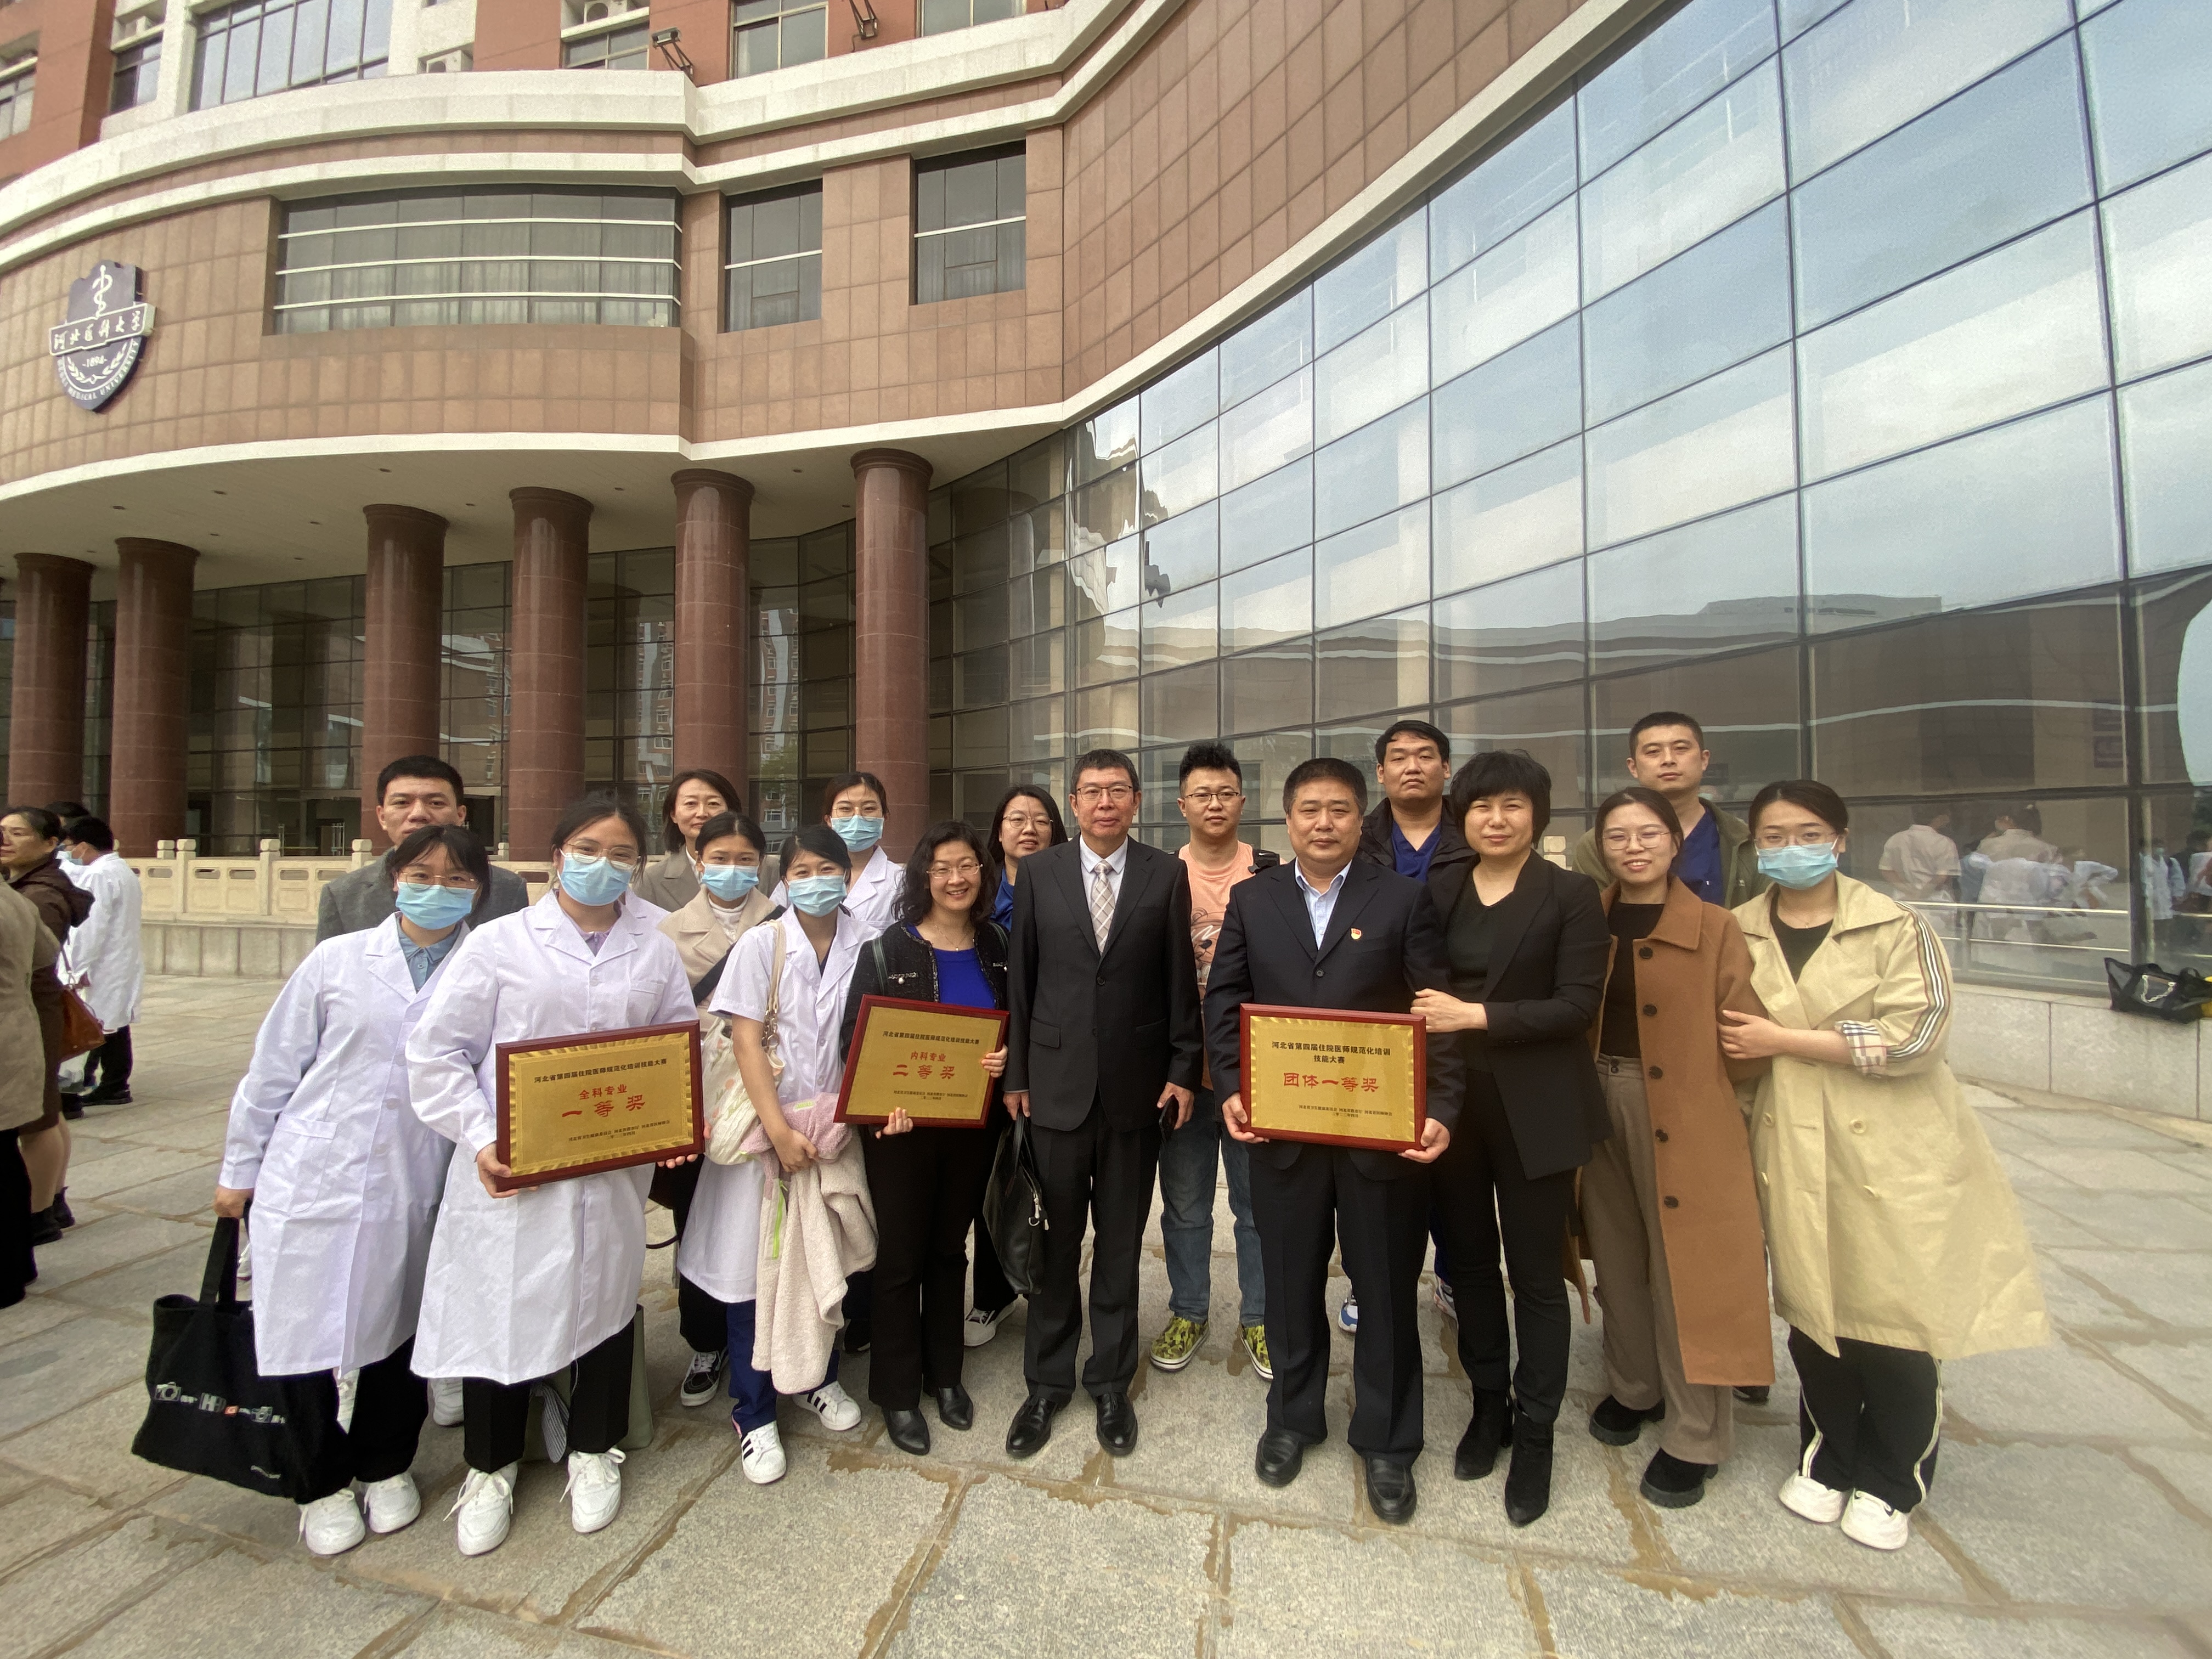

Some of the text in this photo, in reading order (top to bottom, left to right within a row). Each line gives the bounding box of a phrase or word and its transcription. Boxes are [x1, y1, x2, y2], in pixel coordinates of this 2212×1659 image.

[911, 1051, 946, 1062] 内科专业
[1272, 1041, 1391, 1056] 河北省第四届住院医师规范化培训
[1314, 1054, 1345, 1064] 技能大赛
[534, 1058, 667, 1083] 河北省第四届住院医师规范化培训技能大赛
[893, 1064, 955, 1080] 二等奖
[1283, 1073, 1379, 1092] 团体一等奖
[579, 1084, 628, 1100] 全科专业
[562, 1094, 645, 1118] 一等奖
